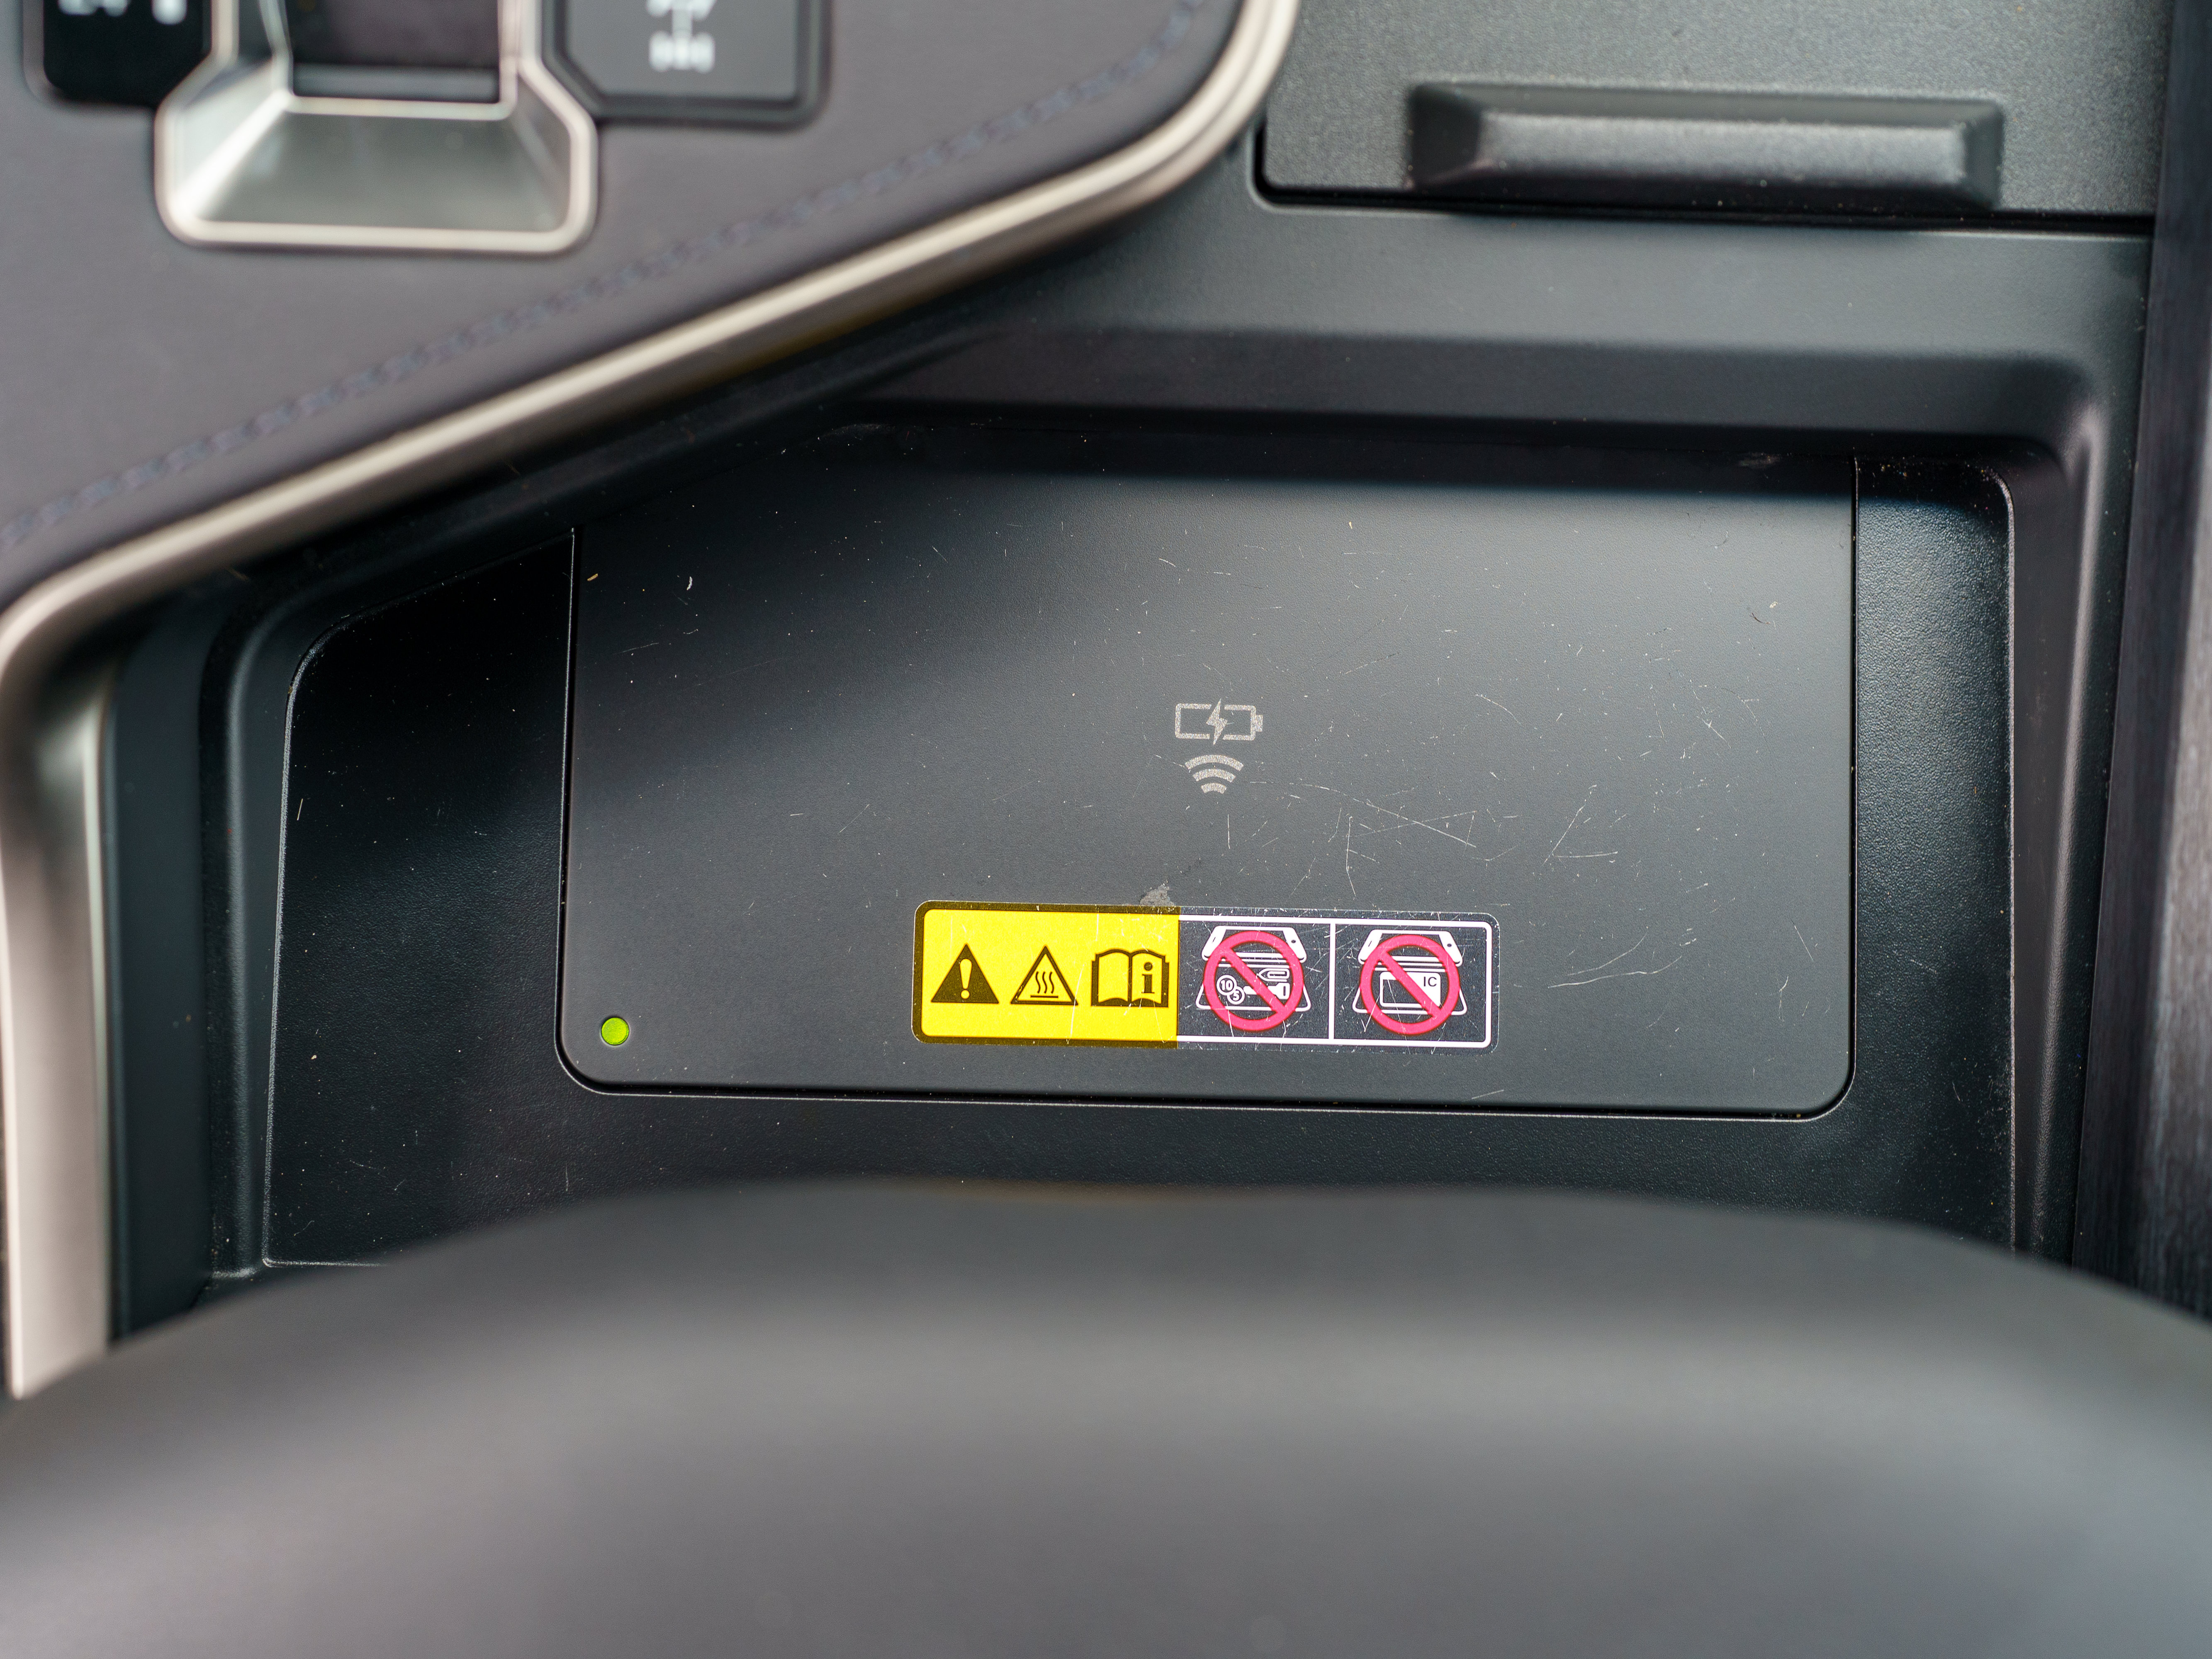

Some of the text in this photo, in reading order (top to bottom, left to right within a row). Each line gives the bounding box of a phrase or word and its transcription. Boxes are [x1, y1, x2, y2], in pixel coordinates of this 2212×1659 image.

[1220, 980, 1233, 991] 10
[1424, 976, 1437, 987] IC
[1232, 990, 1240, 1001] 5
